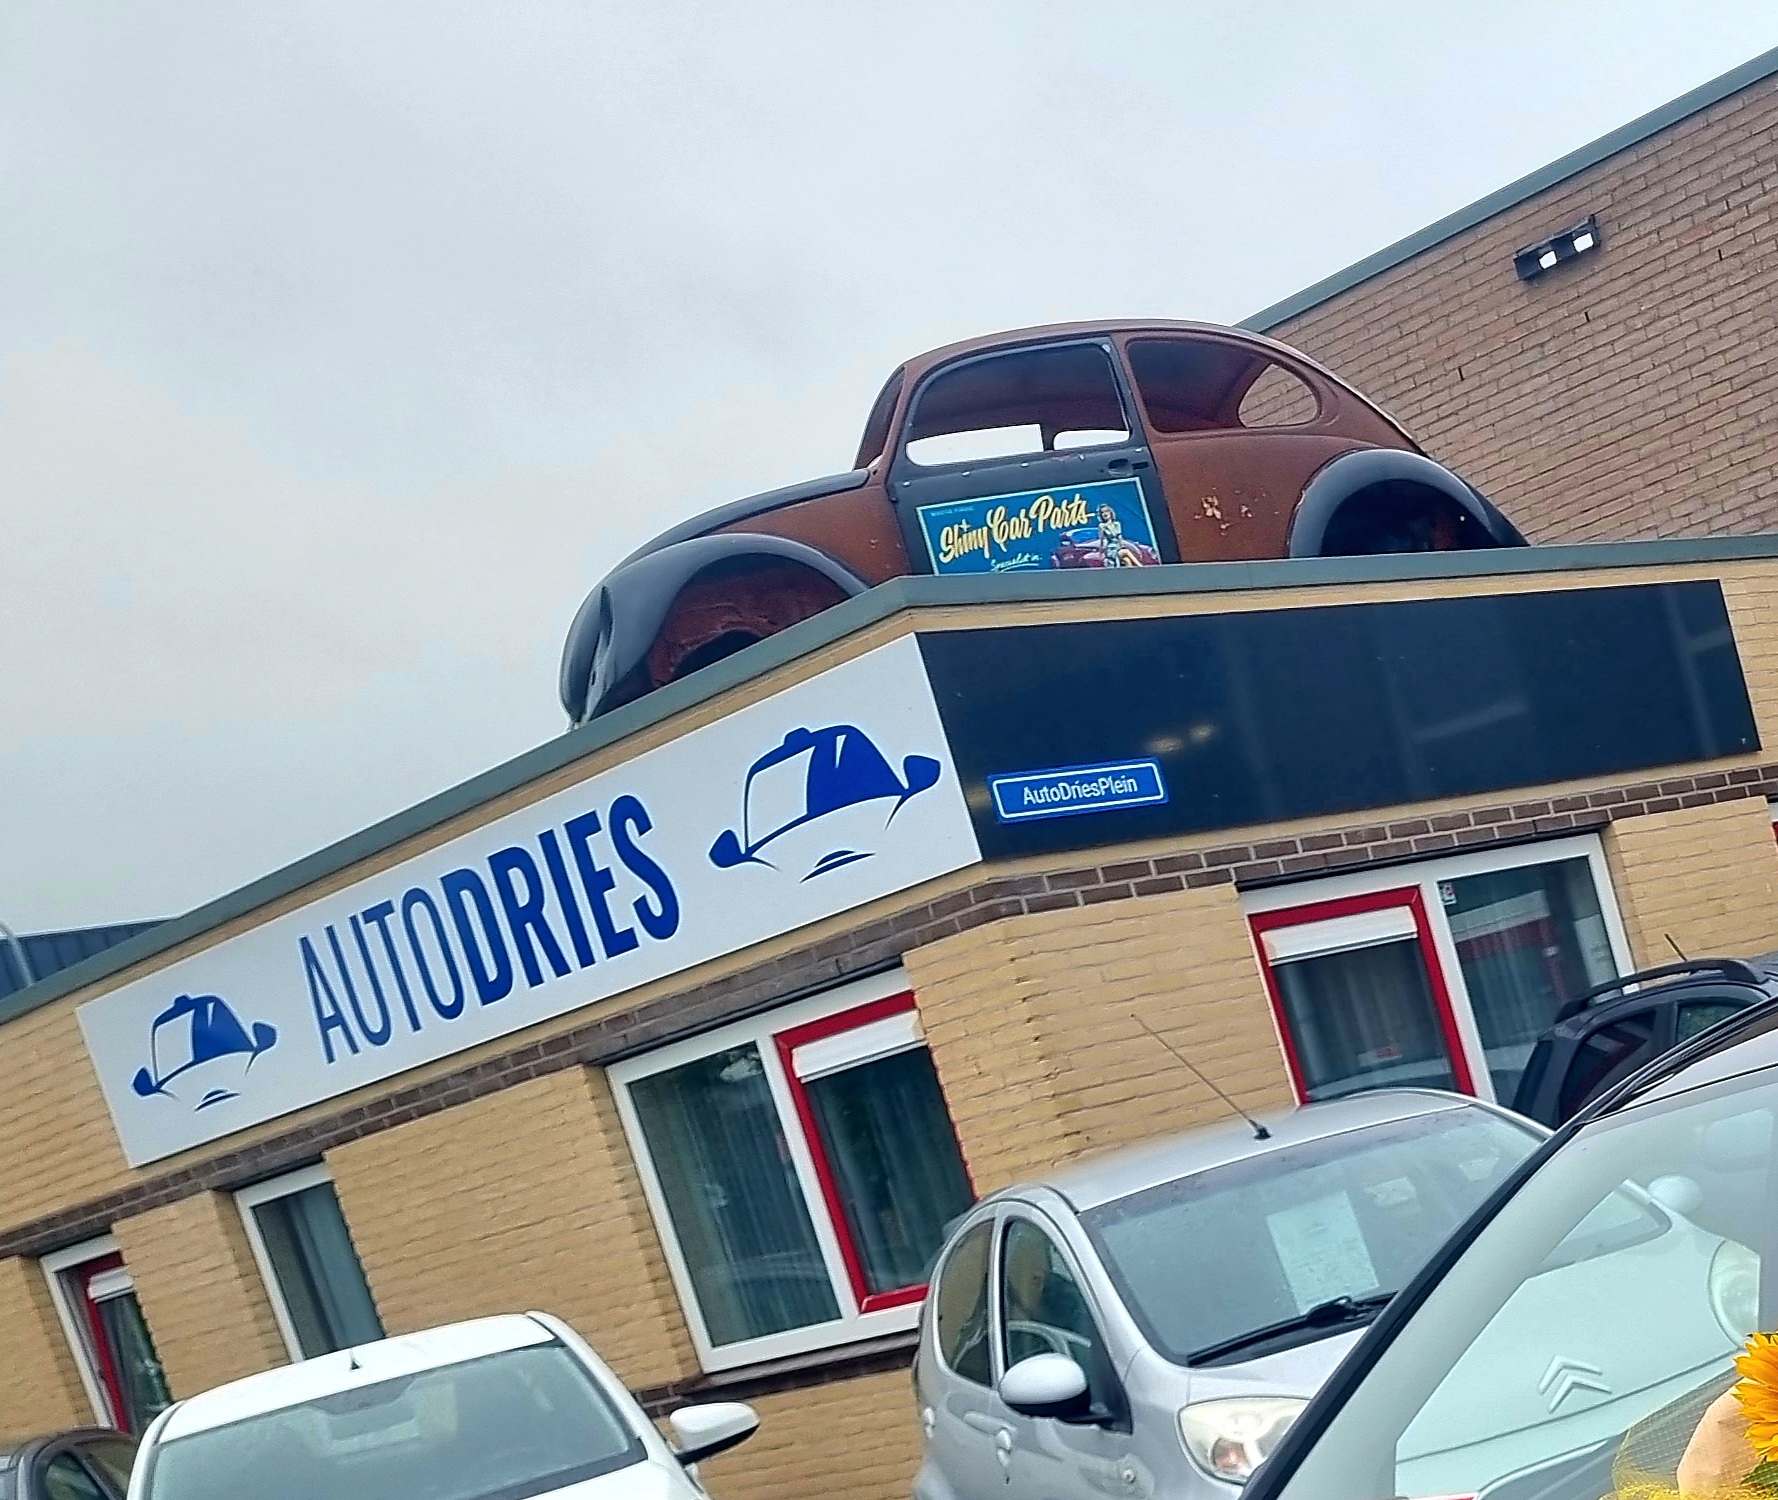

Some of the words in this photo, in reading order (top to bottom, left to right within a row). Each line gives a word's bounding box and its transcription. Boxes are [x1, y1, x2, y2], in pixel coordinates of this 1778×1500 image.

[939, 519, 990, 563] Shiny
[986, 505, 1032, 552] Car
[1029, 493, 1093, 532] Parts
[1023, 775, 1138, 805] AutoDriesPlein
[298, 794, 680, 1064] AUTODRIES
